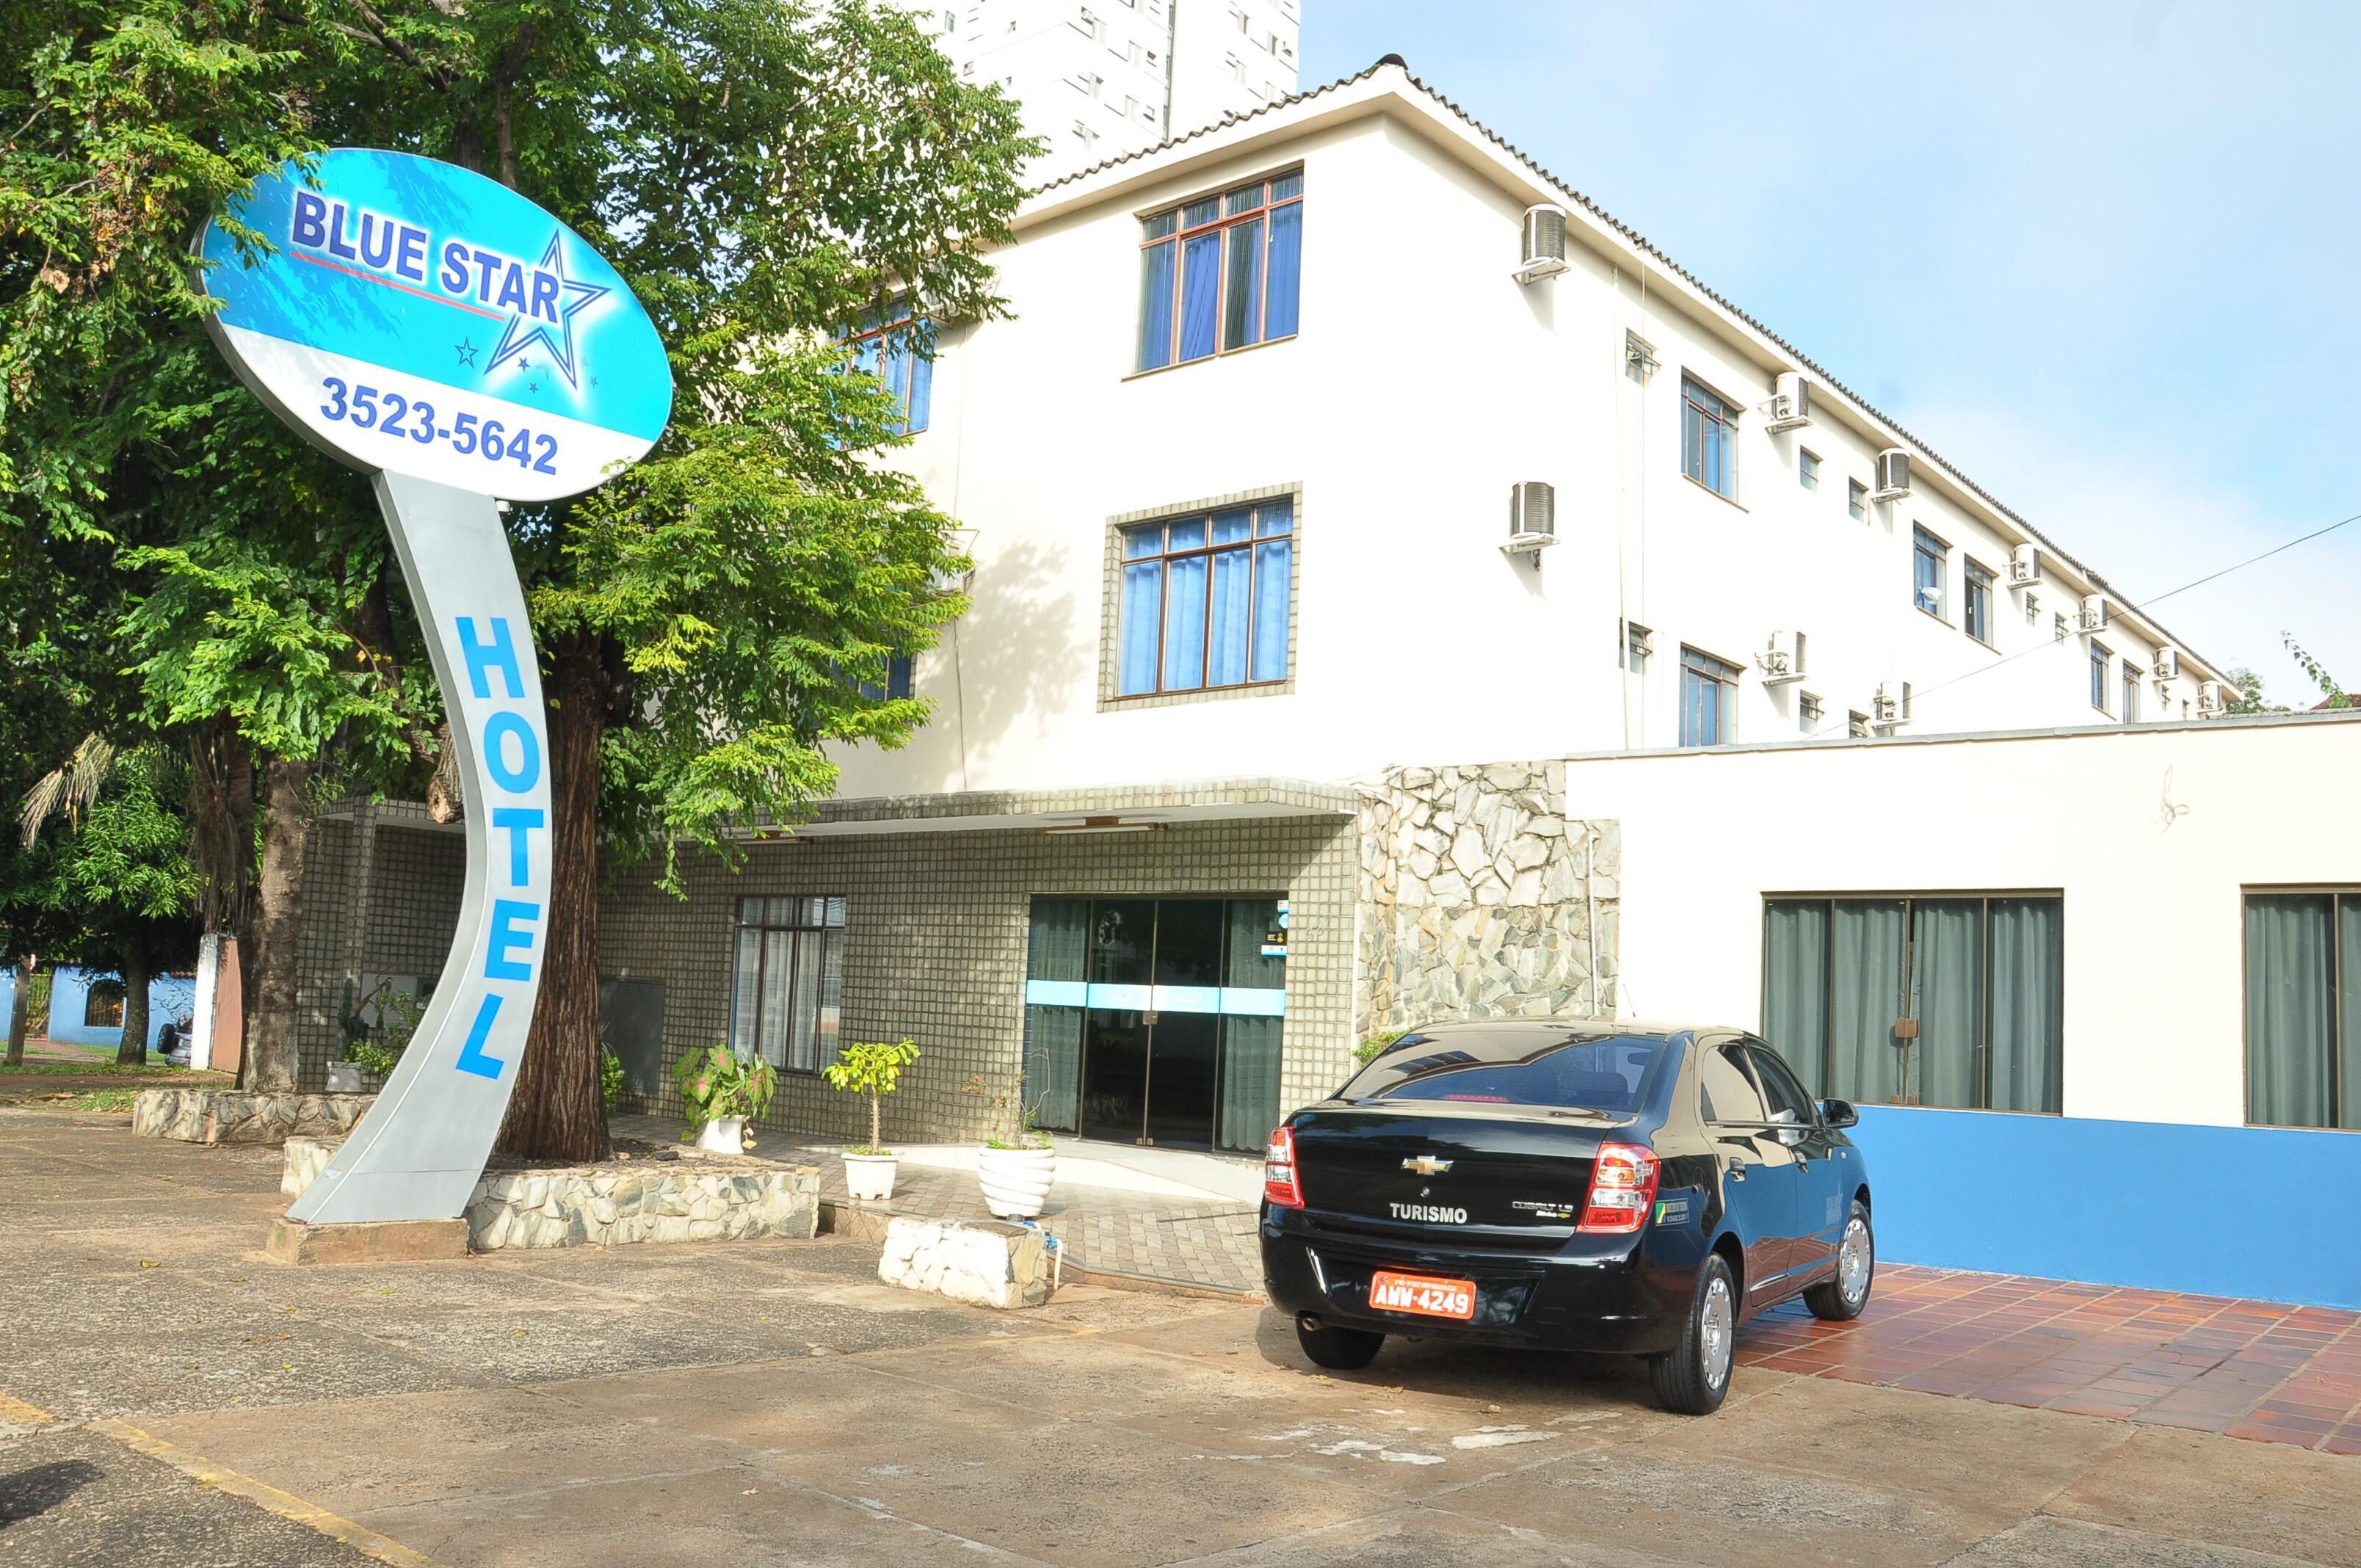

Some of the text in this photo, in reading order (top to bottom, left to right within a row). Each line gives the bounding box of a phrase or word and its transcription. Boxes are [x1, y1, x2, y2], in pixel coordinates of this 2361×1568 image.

[292, 191, 560, 324] BLUE STAR
[320, 376, 559, 476] 3523-5642
[454, 616, 544, 1081] HOTEL
[1390, 1202, 1468, 1224] TURISMO
